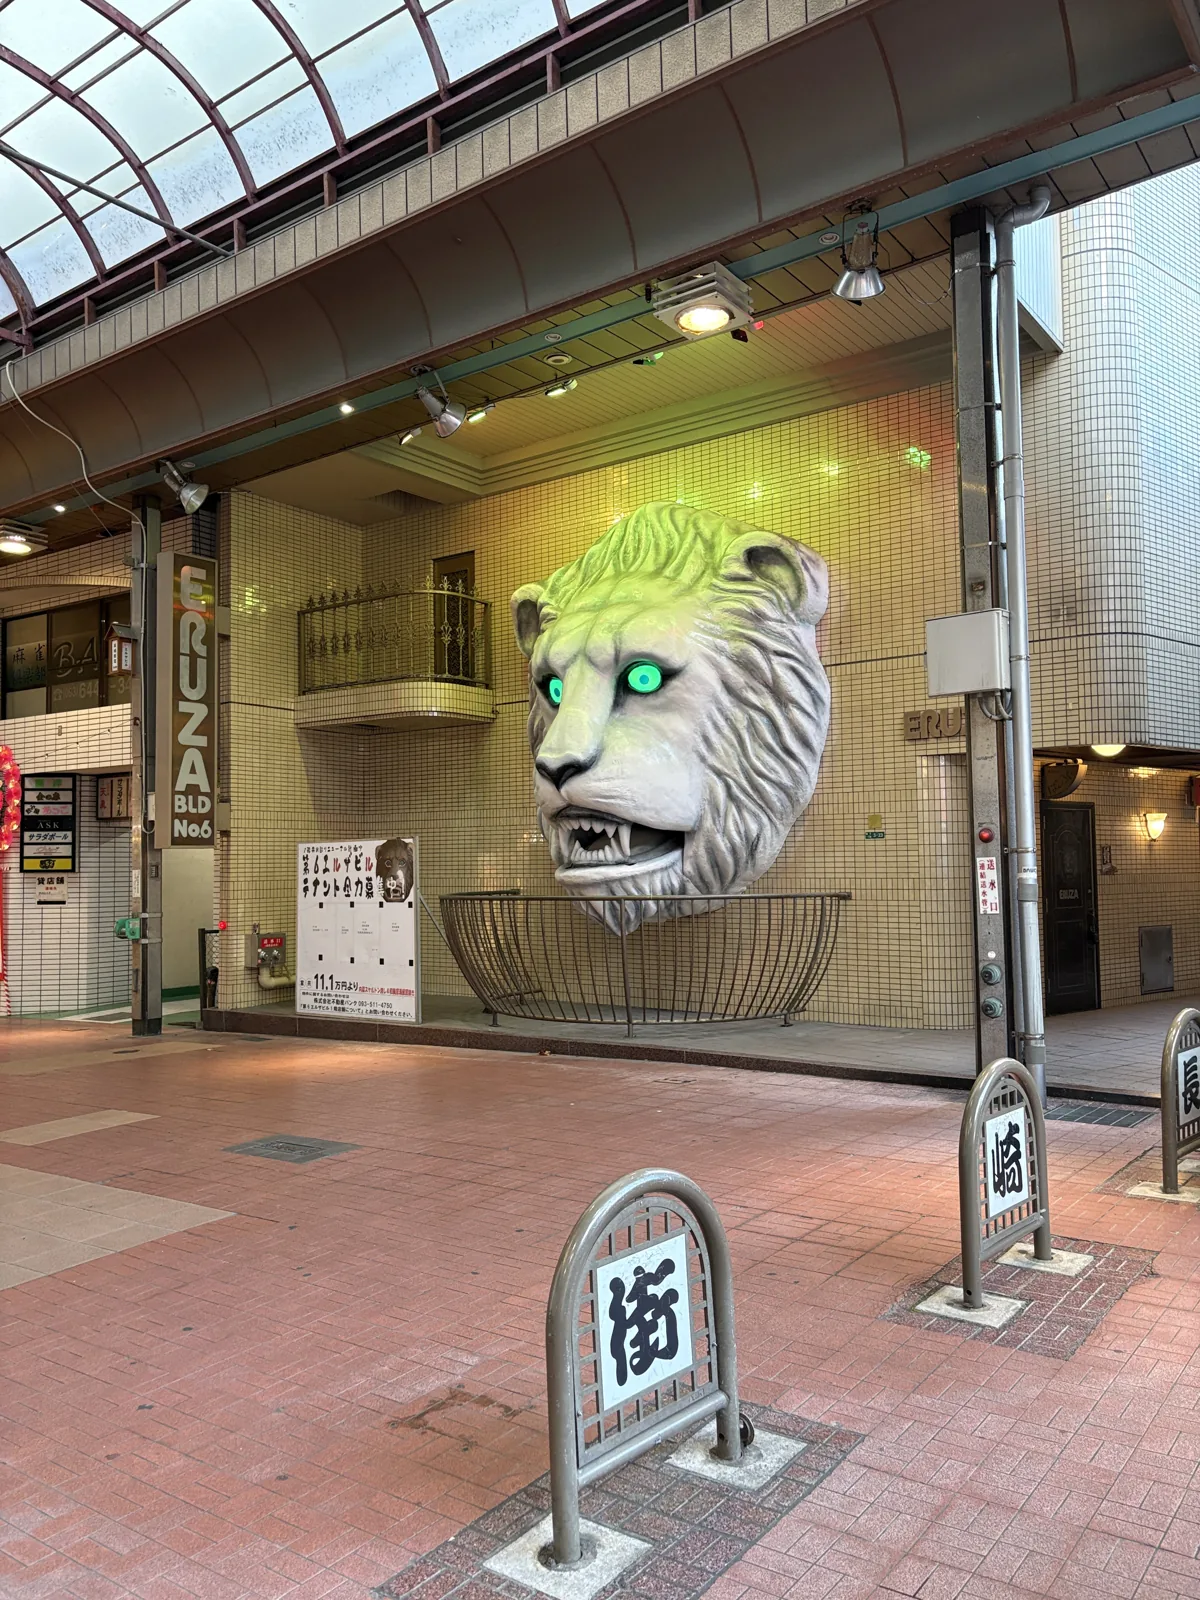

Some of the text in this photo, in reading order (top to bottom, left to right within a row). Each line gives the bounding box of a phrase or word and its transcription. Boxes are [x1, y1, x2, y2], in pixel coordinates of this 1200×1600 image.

[174, 565, 211, 793] ERUZA
[904, 706, 965, 740] ERU
[174, 794, 211, 814] BLD
[37, 821, 60, 829] ASK
[173, 819, 212, 839] No.6
[28, 832, 69, 842] サラダボール
[302, 852, 374, 875] 第6エルザビル
[37, 876, 65, 886] 貸店舗
[986, 859, 998, 912] 送水口
[313, 997, 393, 1009] 株式会社不動産バンク 093-511-4750
[609, 1258, 680, 1387] 街
